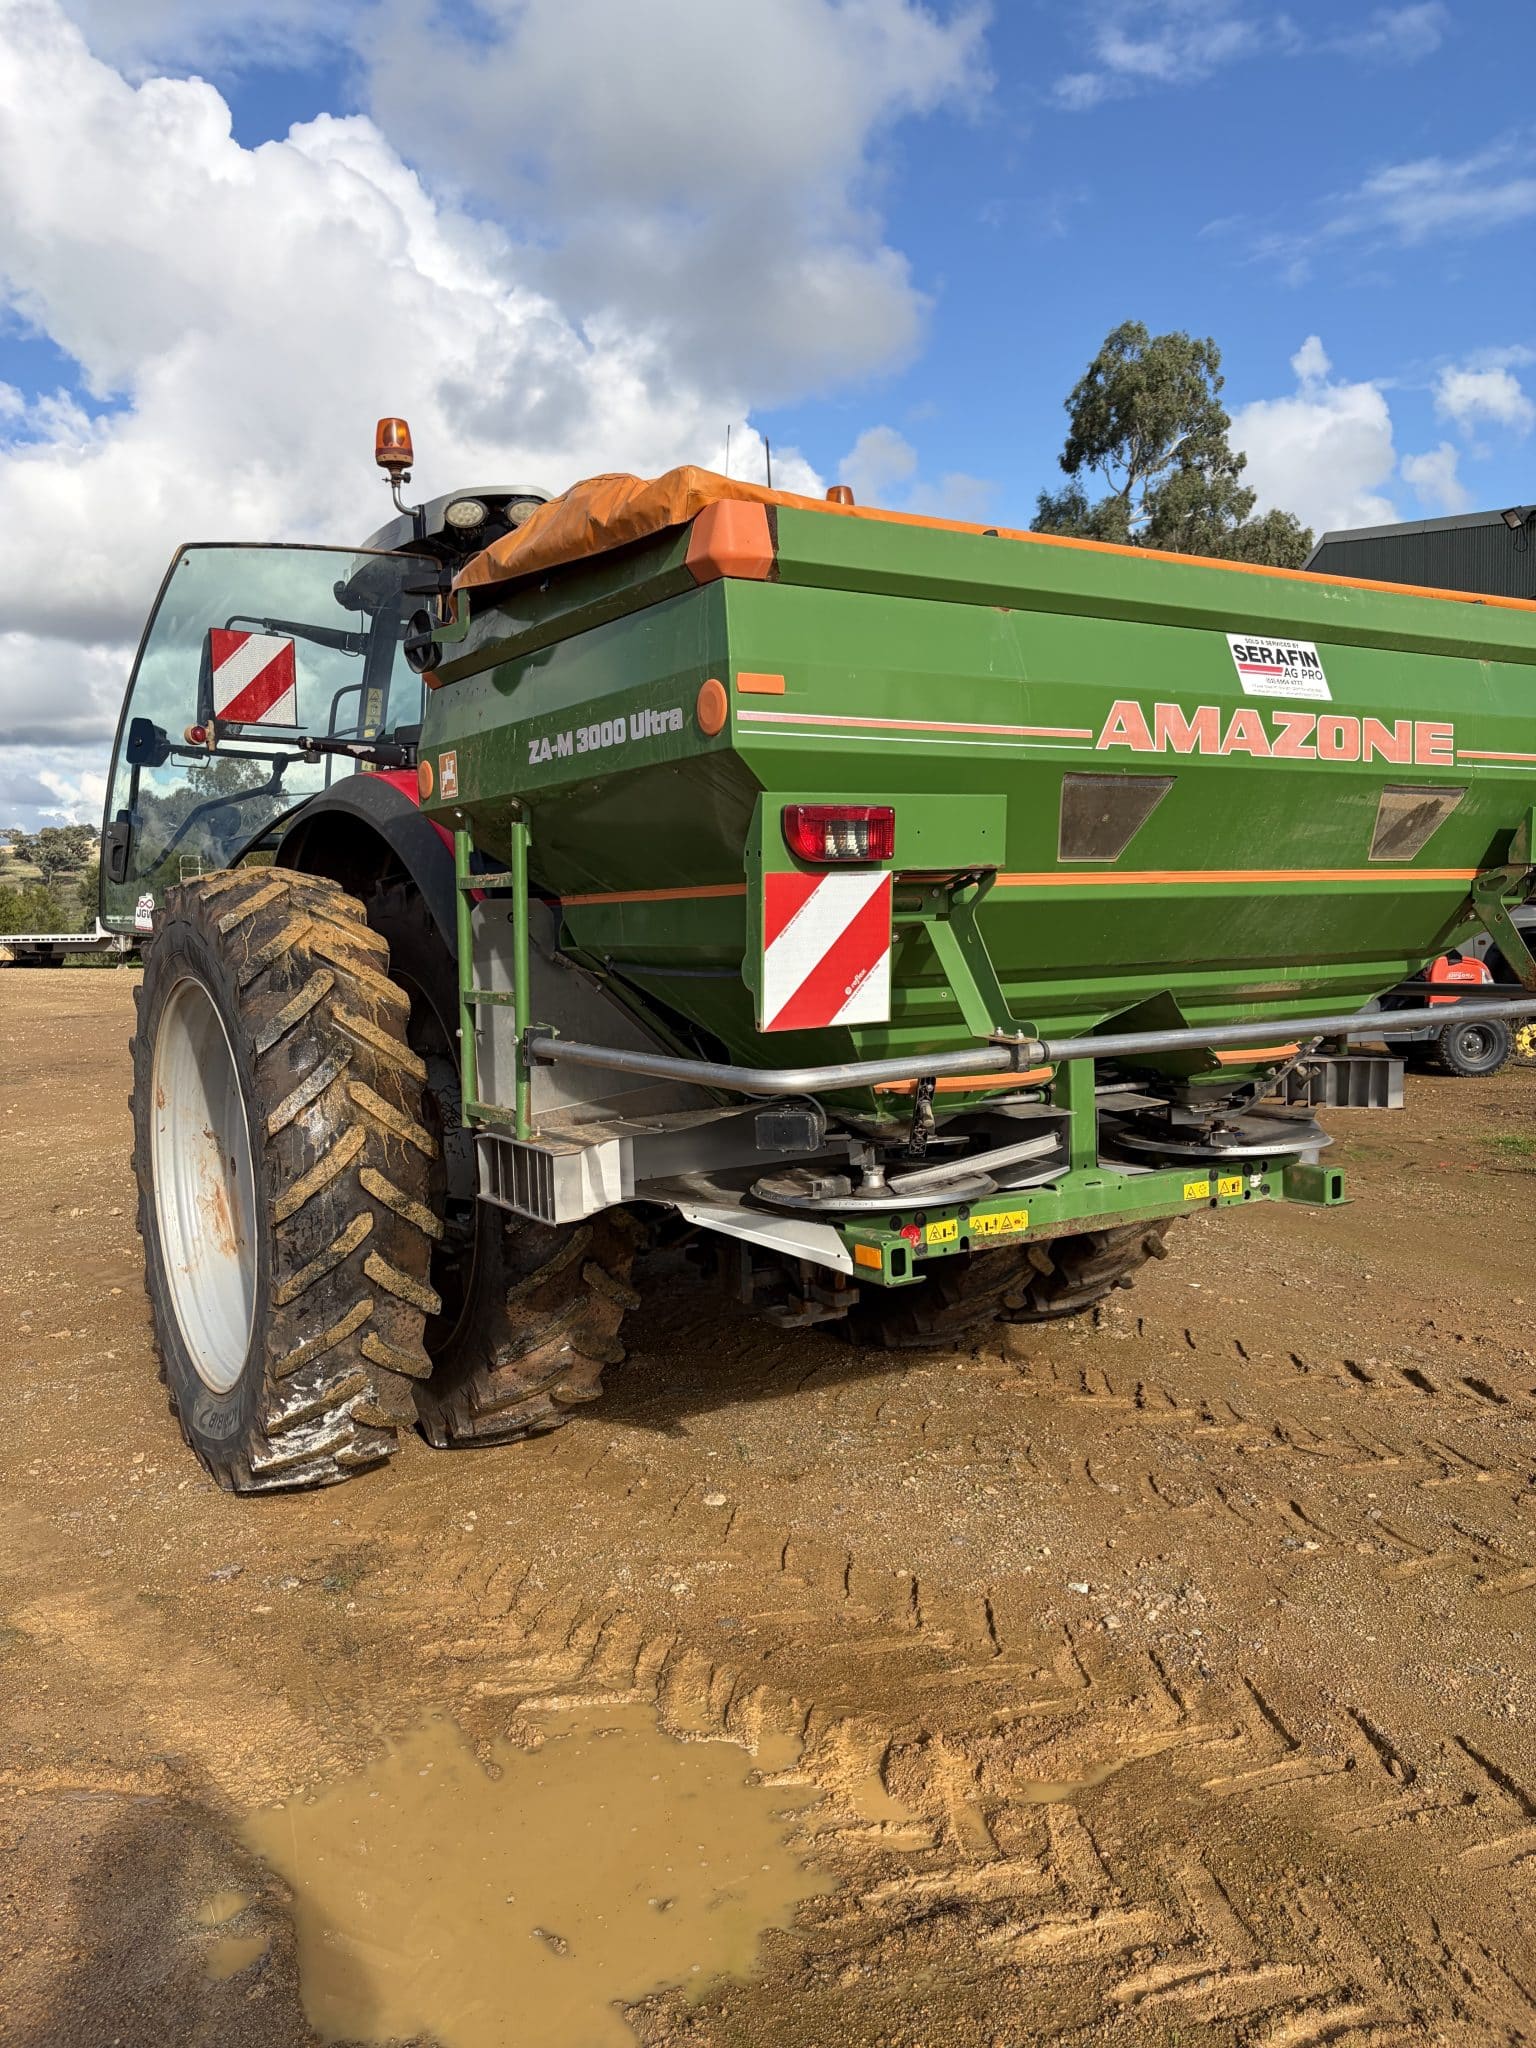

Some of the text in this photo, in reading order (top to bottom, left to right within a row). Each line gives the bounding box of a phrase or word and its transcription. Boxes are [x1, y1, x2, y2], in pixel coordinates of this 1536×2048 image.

[1233, 644, 1319, 668] SERAFIN
[1284, 667, 1323, 681] AG PRO
[528, 707, 683, 764] ZA-M 3000 Ultra
[1095, 700, 1454, 766] AMAZONE
[850, 968, 867, 989] reflex
